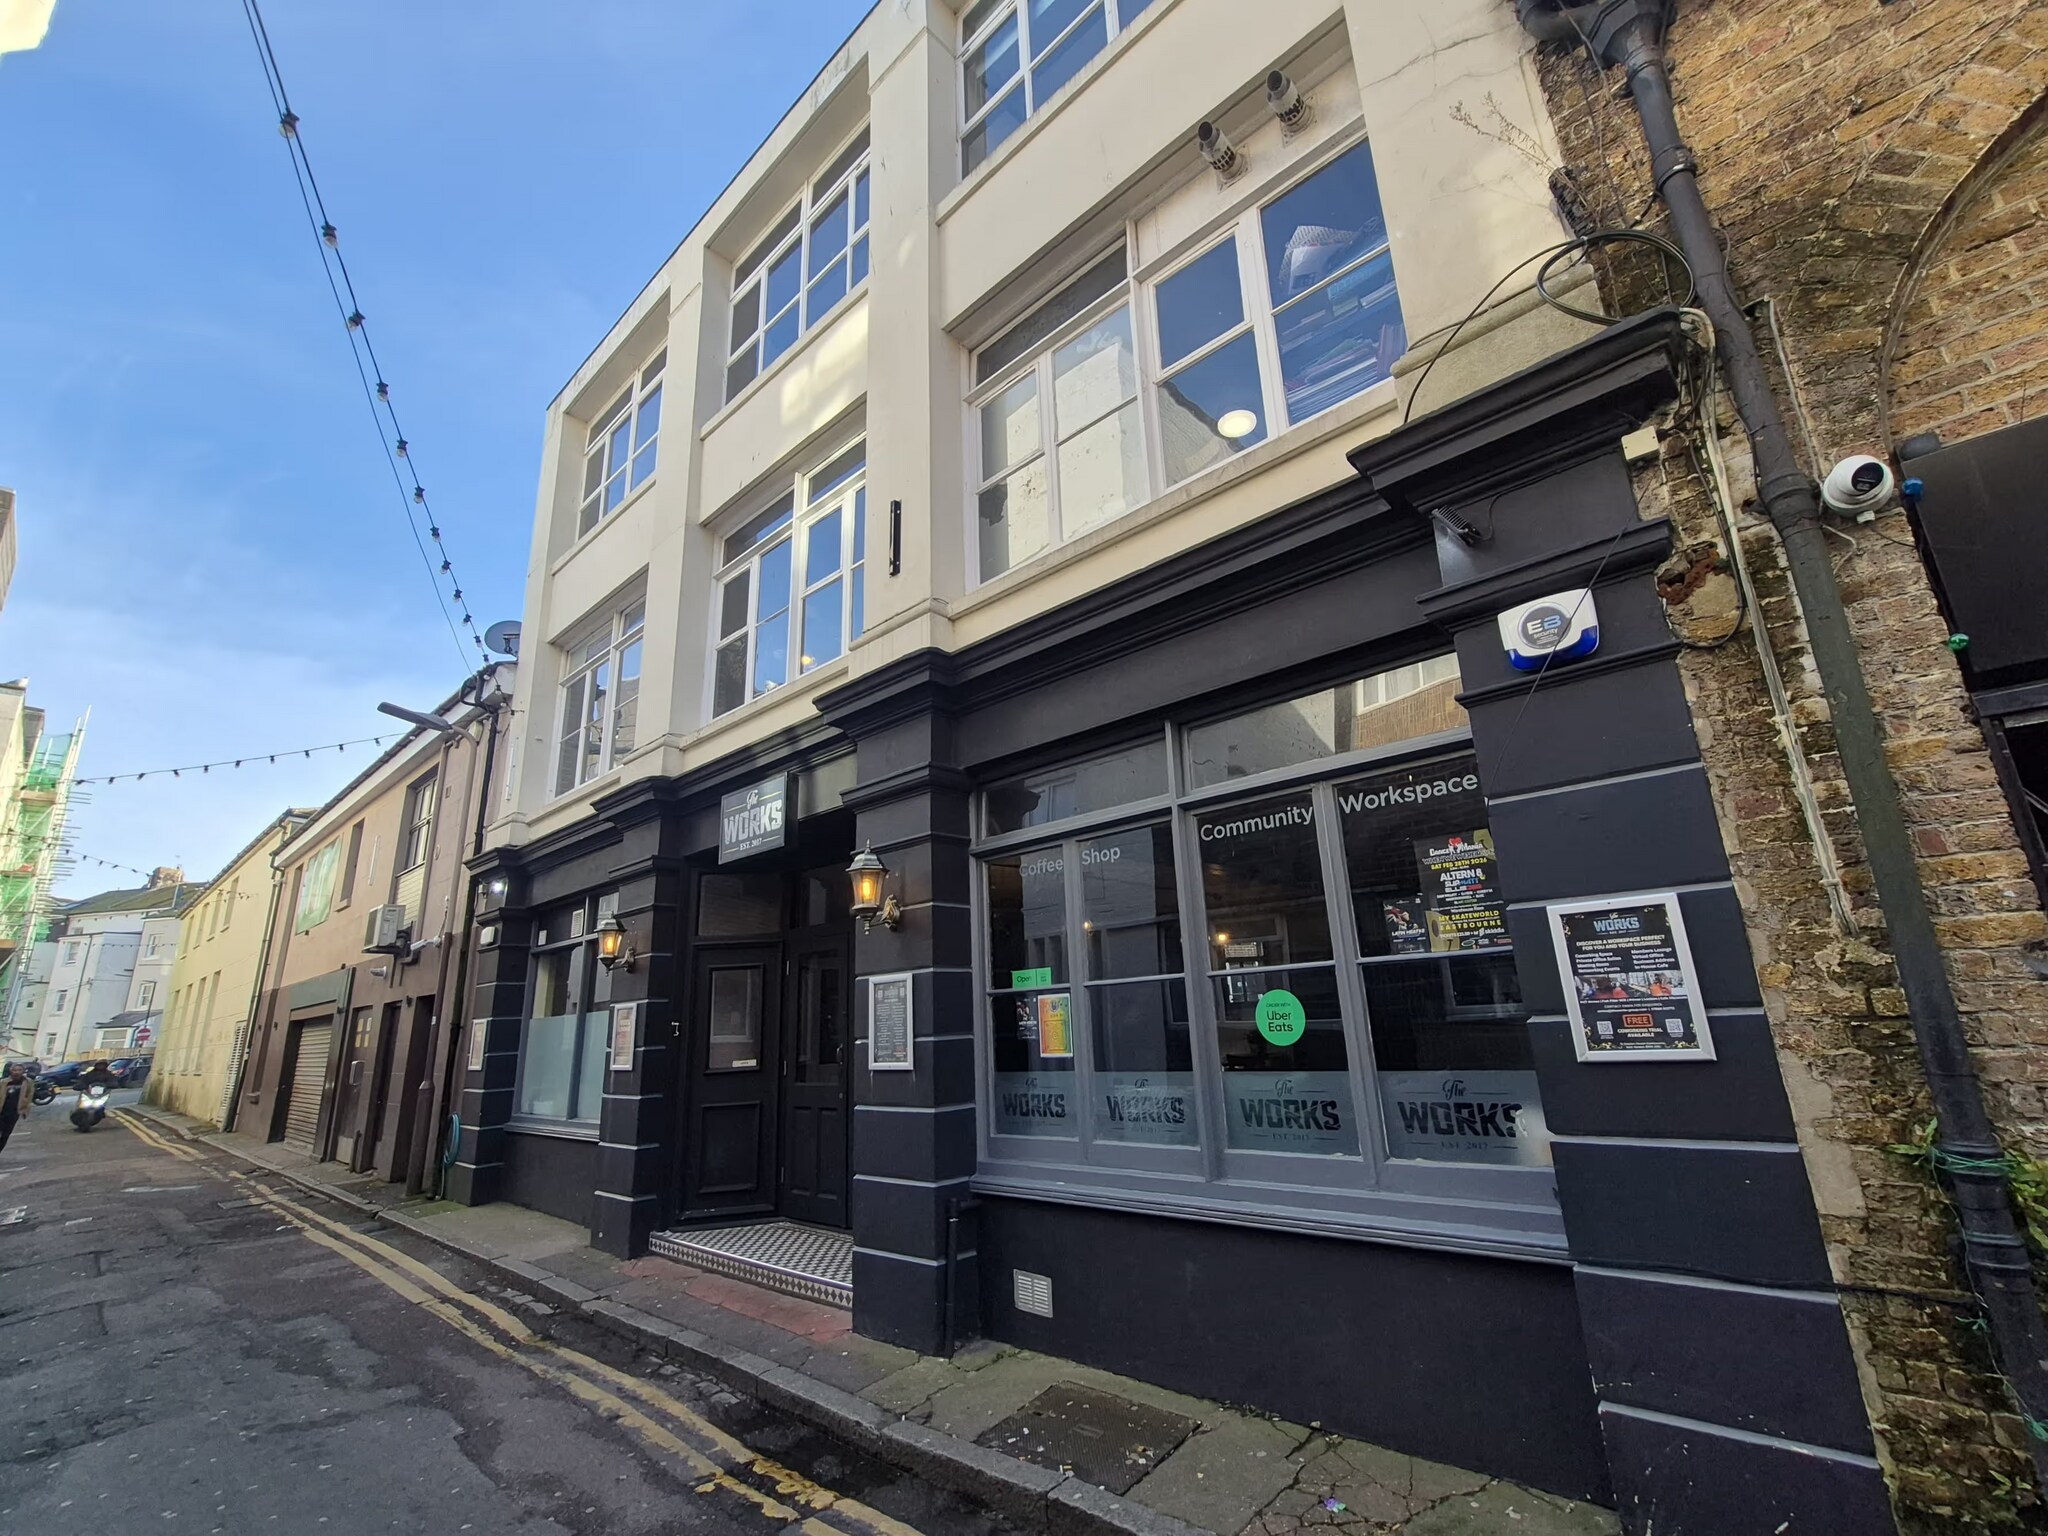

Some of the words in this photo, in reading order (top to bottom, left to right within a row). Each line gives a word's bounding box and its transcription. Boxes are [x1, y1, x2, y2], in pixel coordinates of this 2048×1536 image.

[1527, 615, 1562, 634] EB
[746, 789, 758, 810] The
[723, 799, 782, 845] WORKS
[1019, 859, 1064, 877] Coffee
[1082, 847, 1120, 865] Shop
[1200, 805, 1313, 842] Community
[1339, 774, 1478, 815] Workspace
[1440, 869, 1475, 882] ALTERN
[1440, 919, 1501, 931] EASTBOURNE
[1451, 910, 1500, 921] SKATEWORLD
[1593, 917, 1640, 931] WORKS
[1267, 1010, 1291, 1020] Uber
[1626, 1016, 1649, 1025] FREE
[1268, 1022, 1293, 1032] Eats
[1442, 1079, 1467, 1100] The
[1002, 1093, 1066, 1118] WORKS
[1239, 1098, 1342, 1131] WORKS
[1397, 1101, 1528, 1139] WORKS
